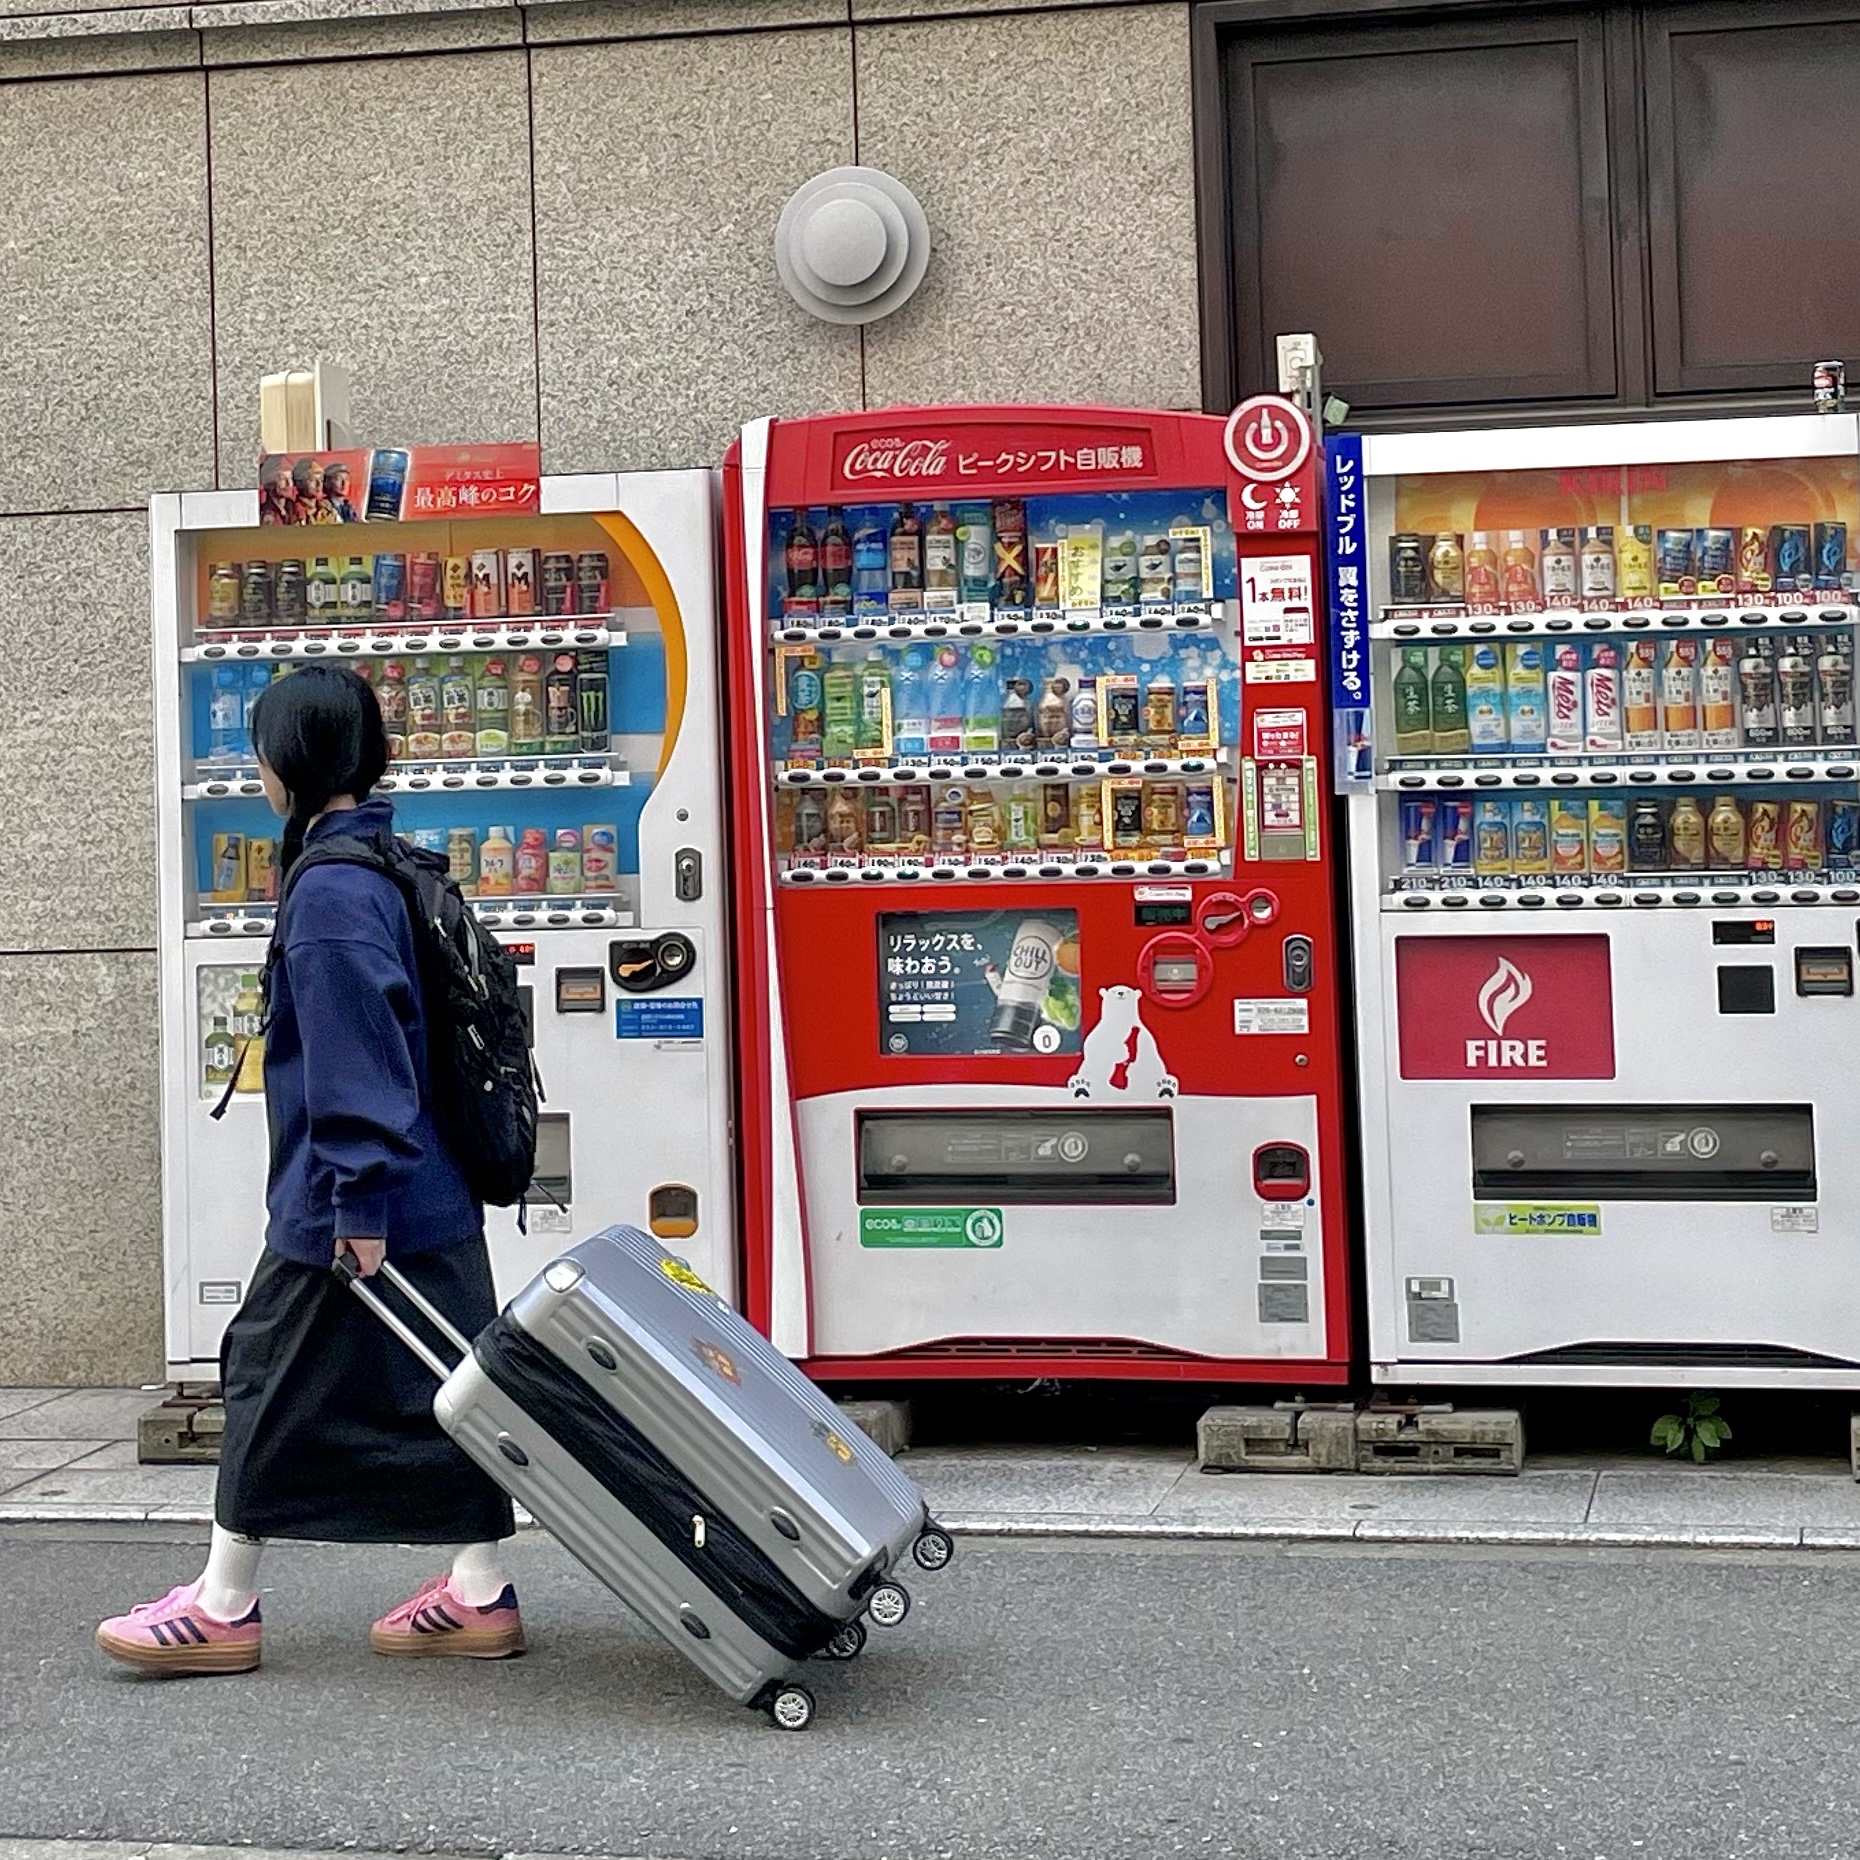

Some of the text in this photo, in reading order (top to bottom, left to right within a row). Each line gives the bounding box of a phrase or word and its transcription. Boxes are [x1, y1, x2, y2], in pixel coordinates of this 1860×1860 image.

[957, 444, 1145, 476] ピークシフト自販機
[413, 482, 537, 510] 最高峰のコク
[1246, 518, 1301, 531] ON OFF
[1335, 454, 1362, 701] レッドブル 翼をさずける。
[888, 932, 984, 953] リラックスを、
[1012, 944, 1049, 965] CHILL
[1013, 957, 1043, 972] OUT
[887, 956, 962, 976] 味わおう。
[1465, 1038, 1548, 1068] FIRE
